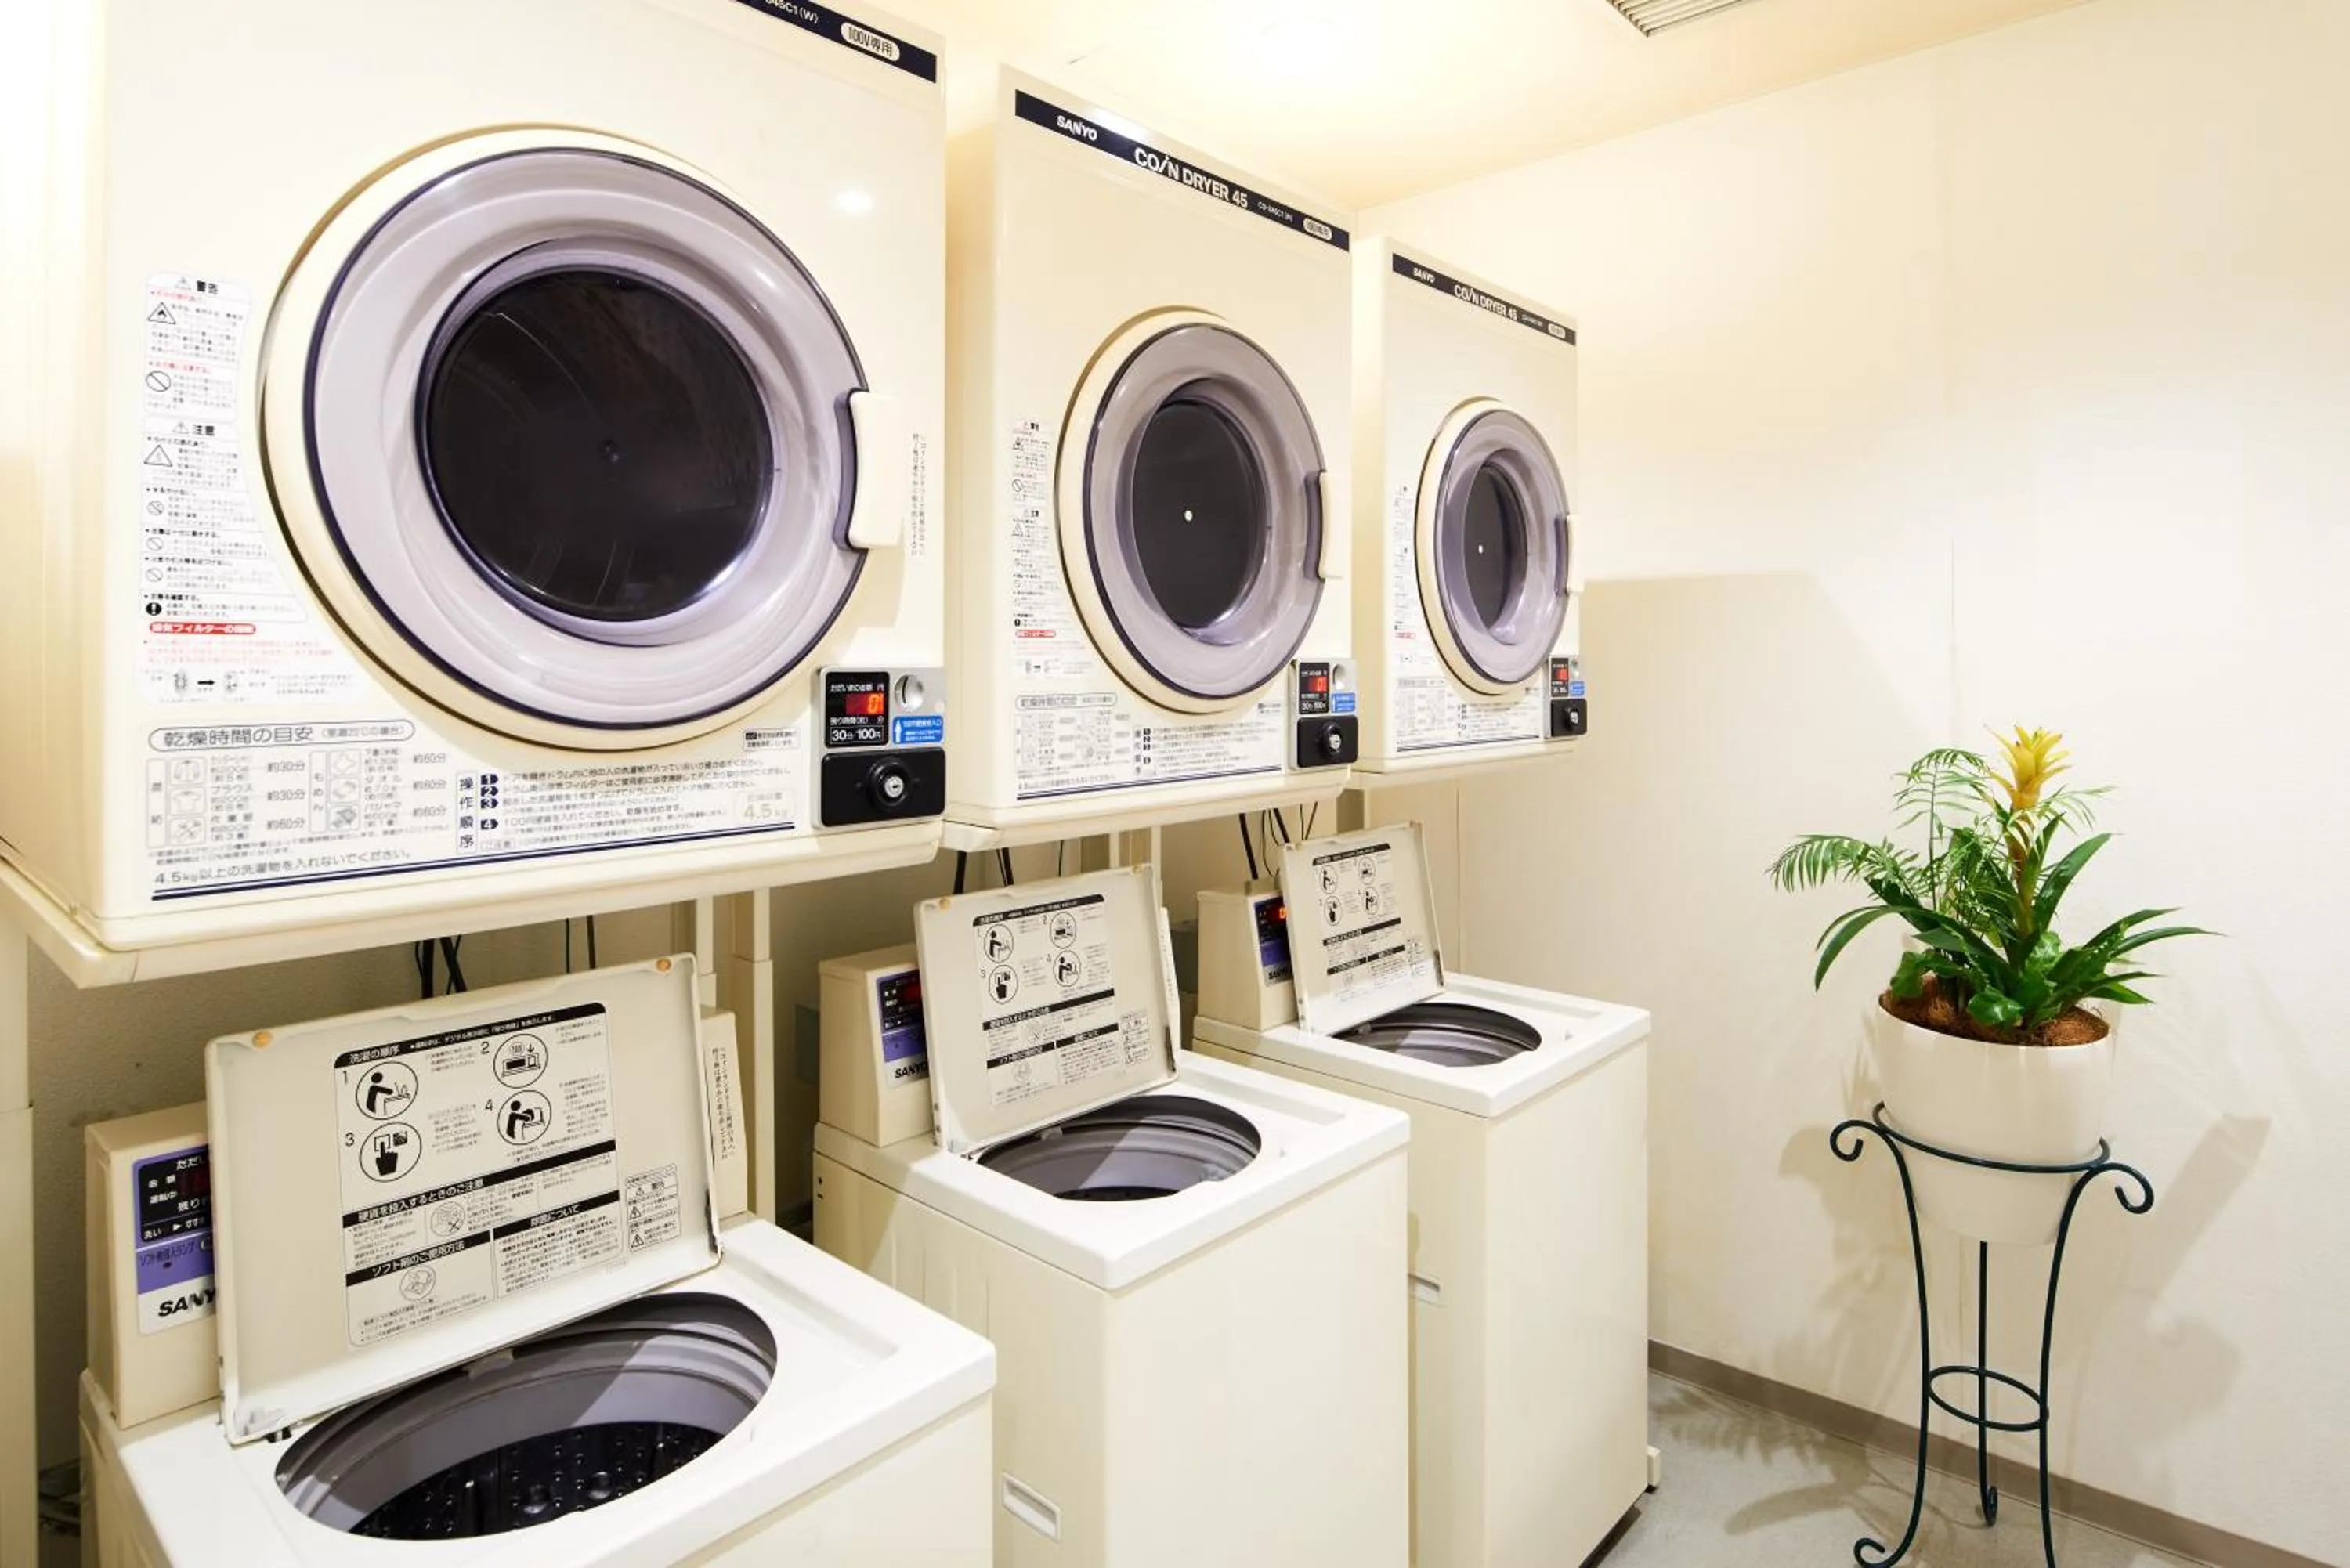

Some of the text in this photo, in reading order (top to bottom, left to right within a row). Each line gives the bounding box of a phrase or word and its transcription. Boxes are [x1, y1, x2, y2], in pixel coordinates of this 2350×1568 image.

[1057, 115, 1097, 141] SANYO
[1182, 167, 1229, 201] DRYER
[1232, 190, 1249, 208] 45
[1413, 267, 1436, 284] SANYO
[164, 726, 313, 747] 乾燥時間の目安
[480, 1041, 490, 1055] 2
[485, 1099, 494, 1111] 4
[345, 1133, 356, 1147] 3
